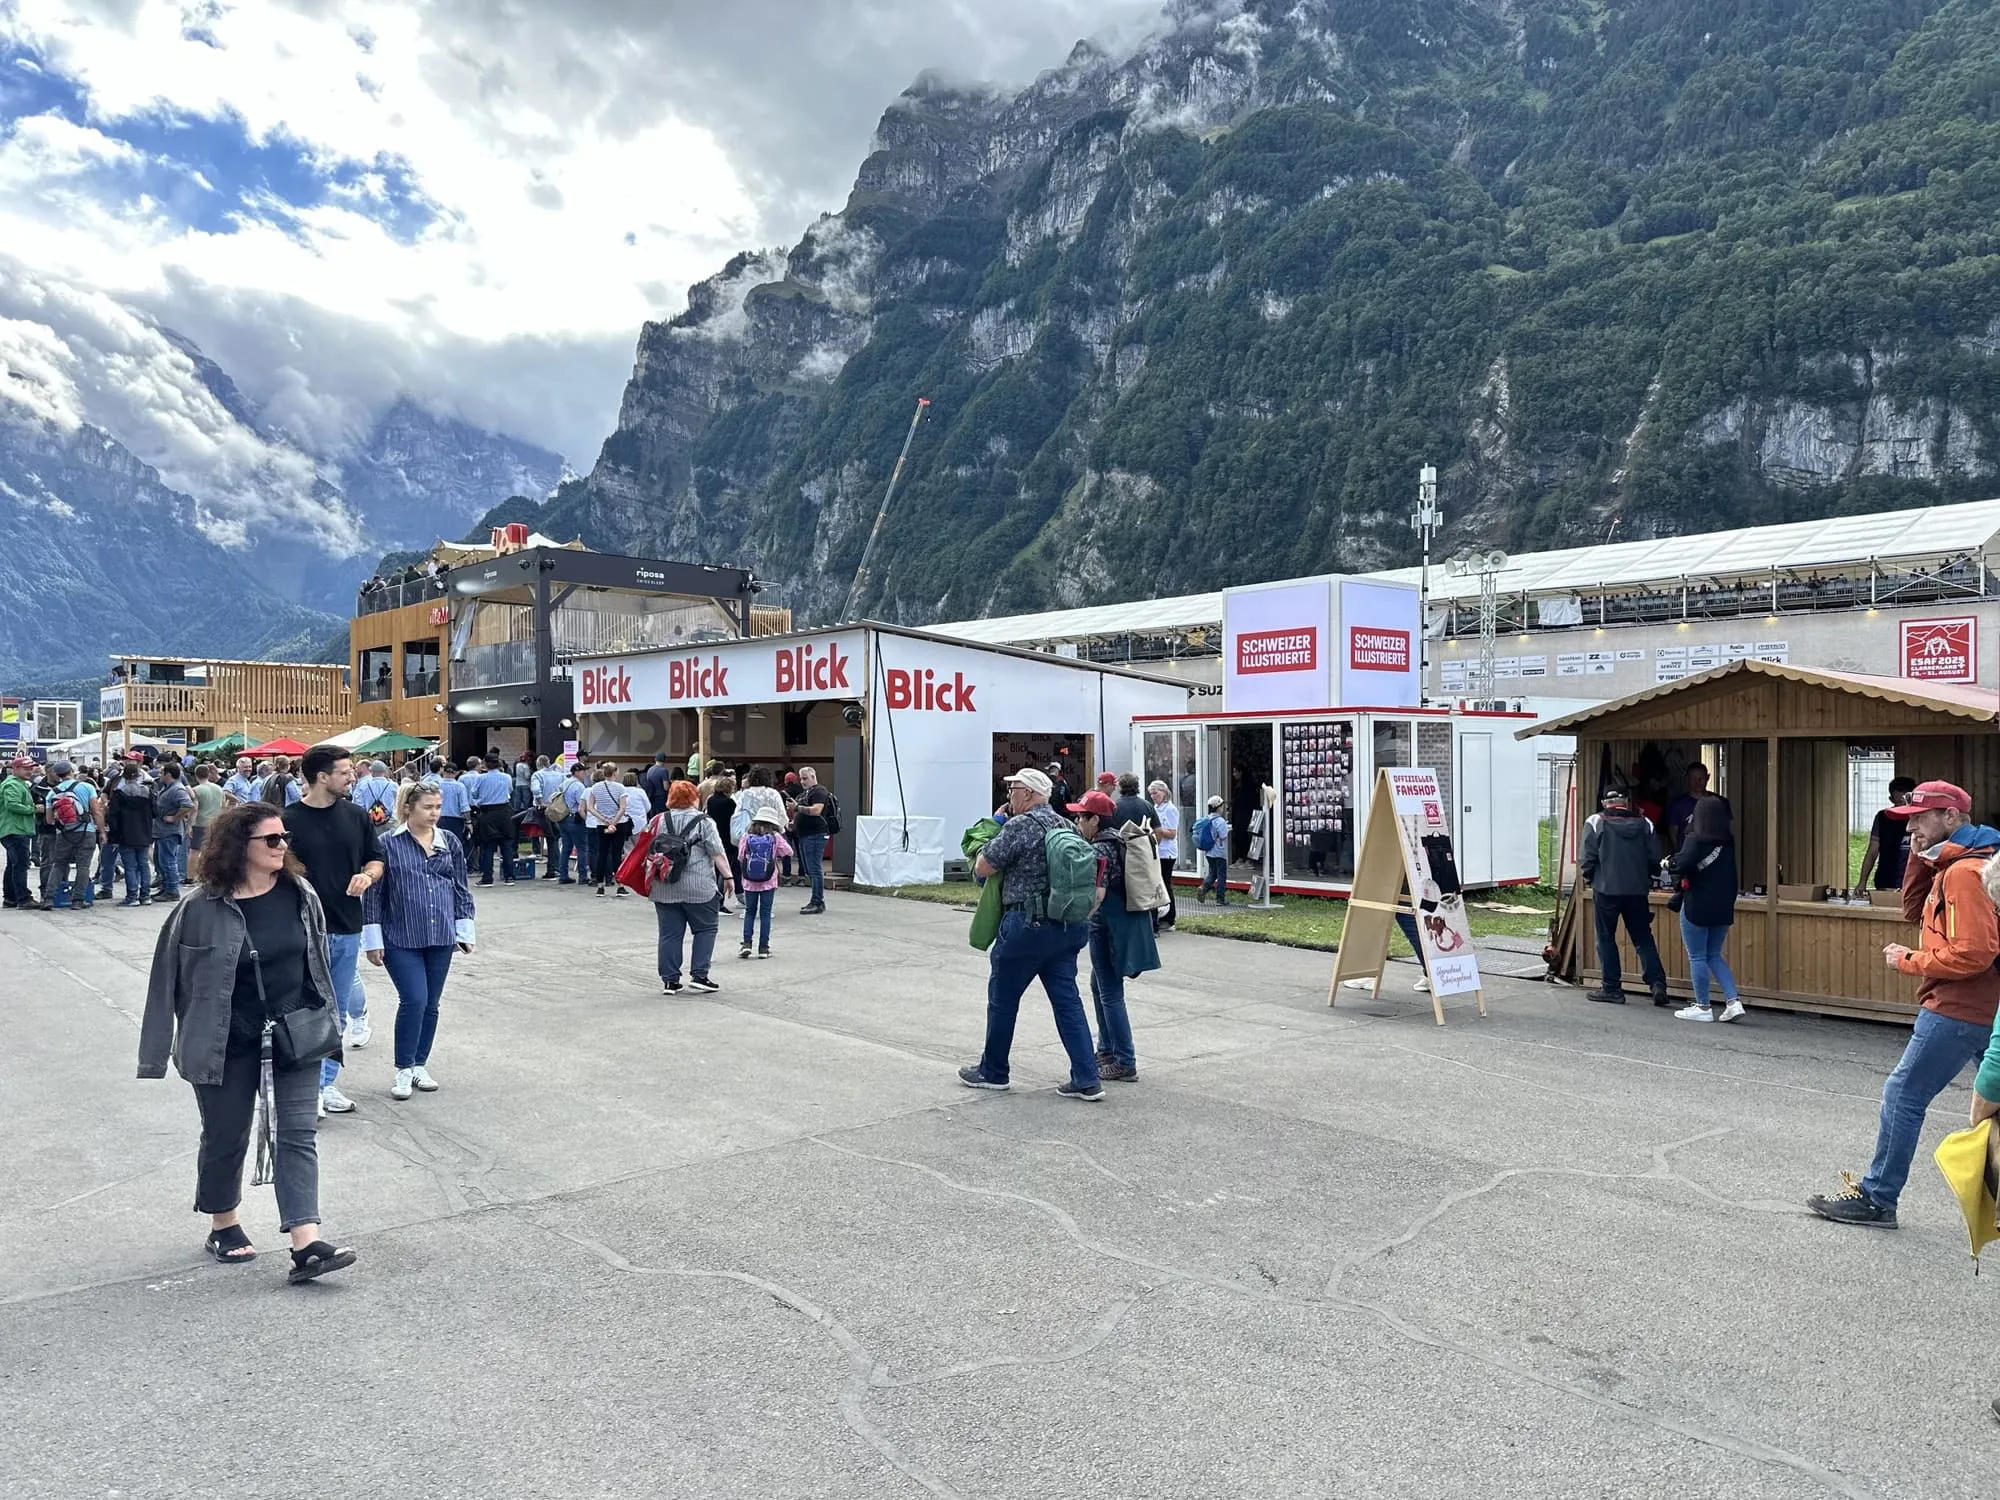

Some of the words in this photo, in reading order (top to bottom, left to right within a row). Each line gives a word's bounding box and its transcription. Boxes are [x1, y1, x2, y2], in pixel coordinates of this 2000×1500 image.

[636, 567, 665, 579] riposa
[1242, 634, 1311, 654] SCHWEIZER
[1354, 633, 1406, 652] SCHWEIZER
[1242, 650, 1311, 668] ILLUSTRIERTE
[1354, 649, 1406, 666] ILLUSTRIERTE
[1911, 657, 1937, 665] ESAF
[775, 643, 849, 693] Blick
[582, 665, 632, 705] Blick
[669, 656, 728, 699] Blick
[886, 668, 977, 712] Blick
[1393, 775, 1434, 783] OFFIZIELLER
[1396, 784, 1436, 796] FANSHOP
